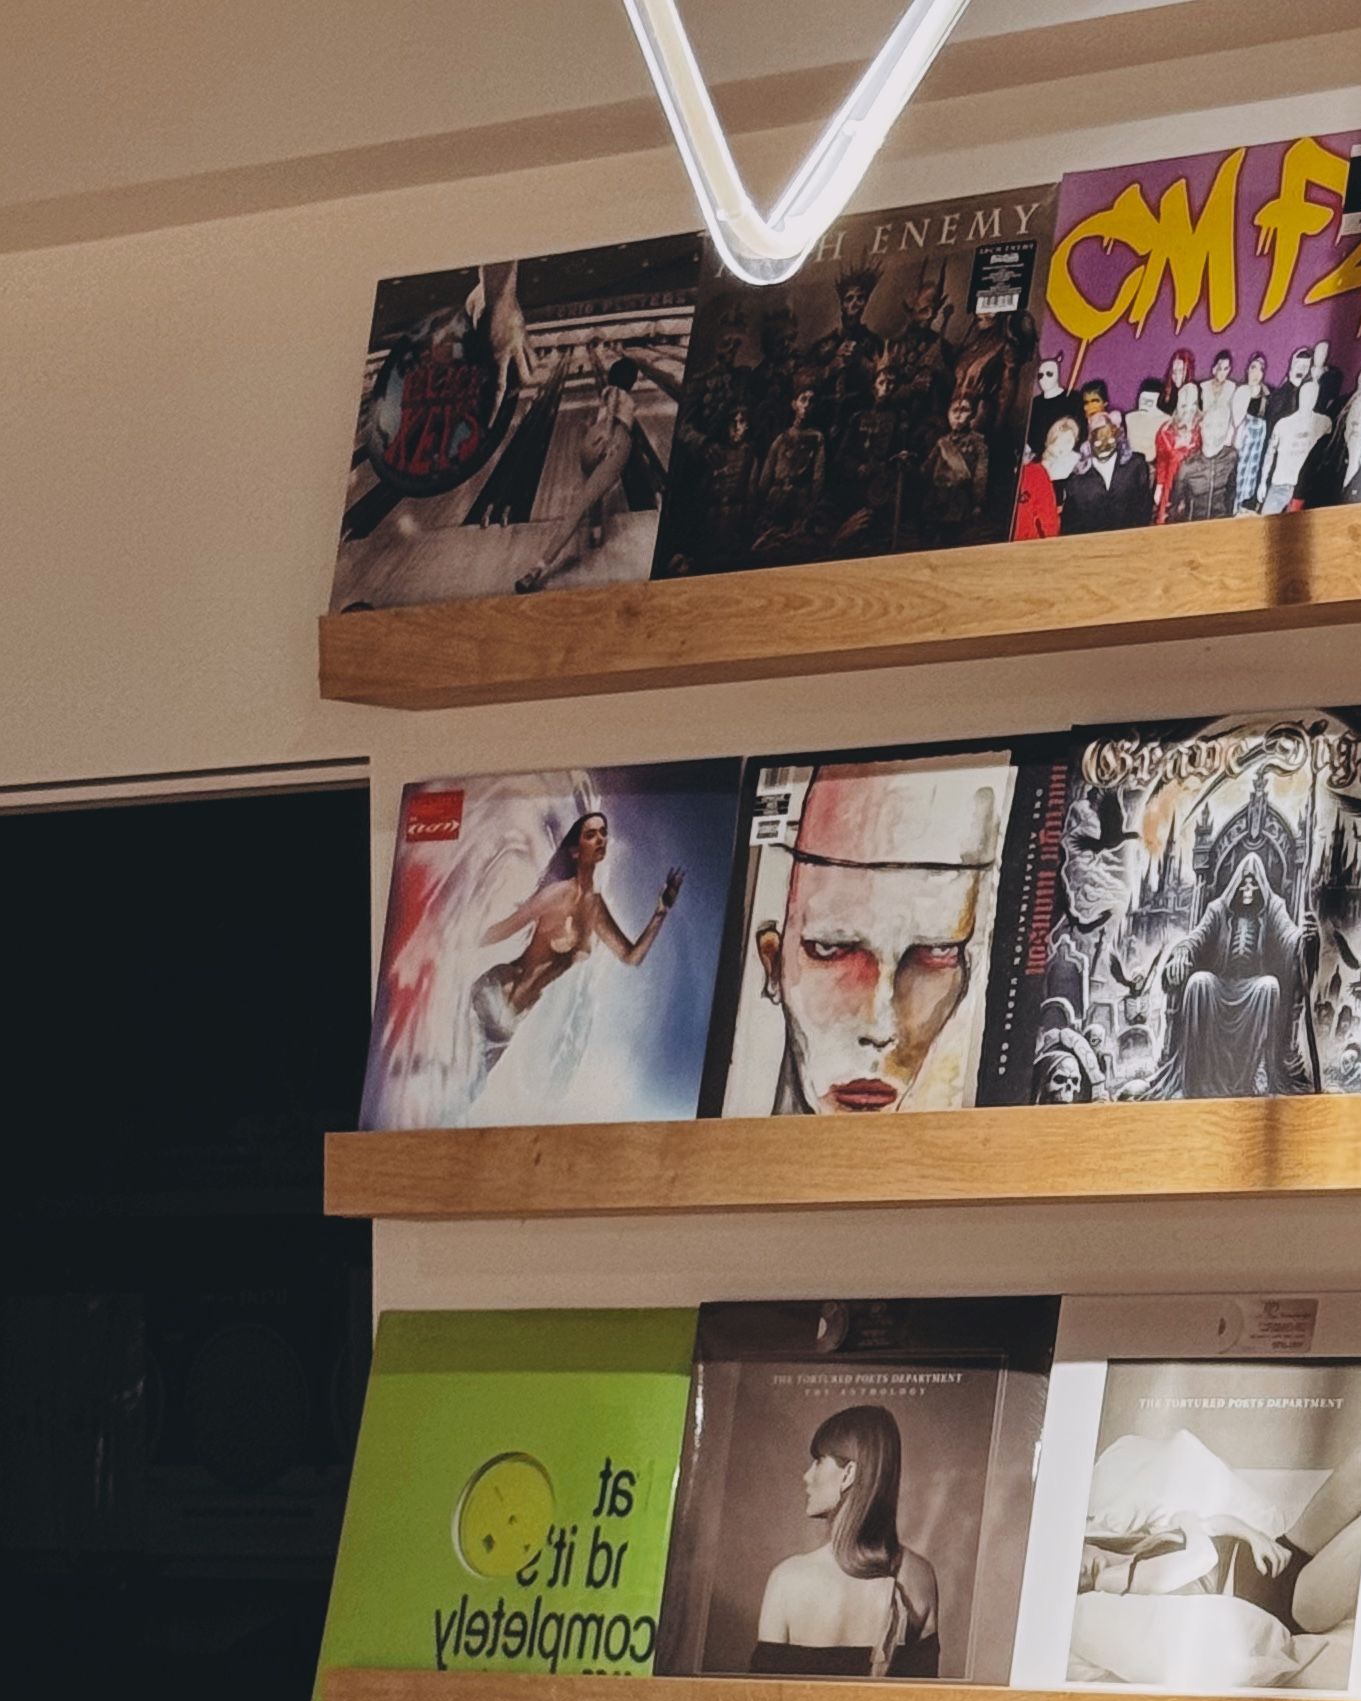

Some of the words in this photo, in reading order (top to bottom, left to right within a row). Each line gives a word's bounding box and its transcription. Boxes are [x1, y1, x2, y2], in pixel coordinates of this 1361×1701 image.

[872, 203, 1041, 255] ENEMY
[891, 1373, 962, 1384] DEPARTMENT
[1266, 1398, 1344, 1409] DEPARTMENT
